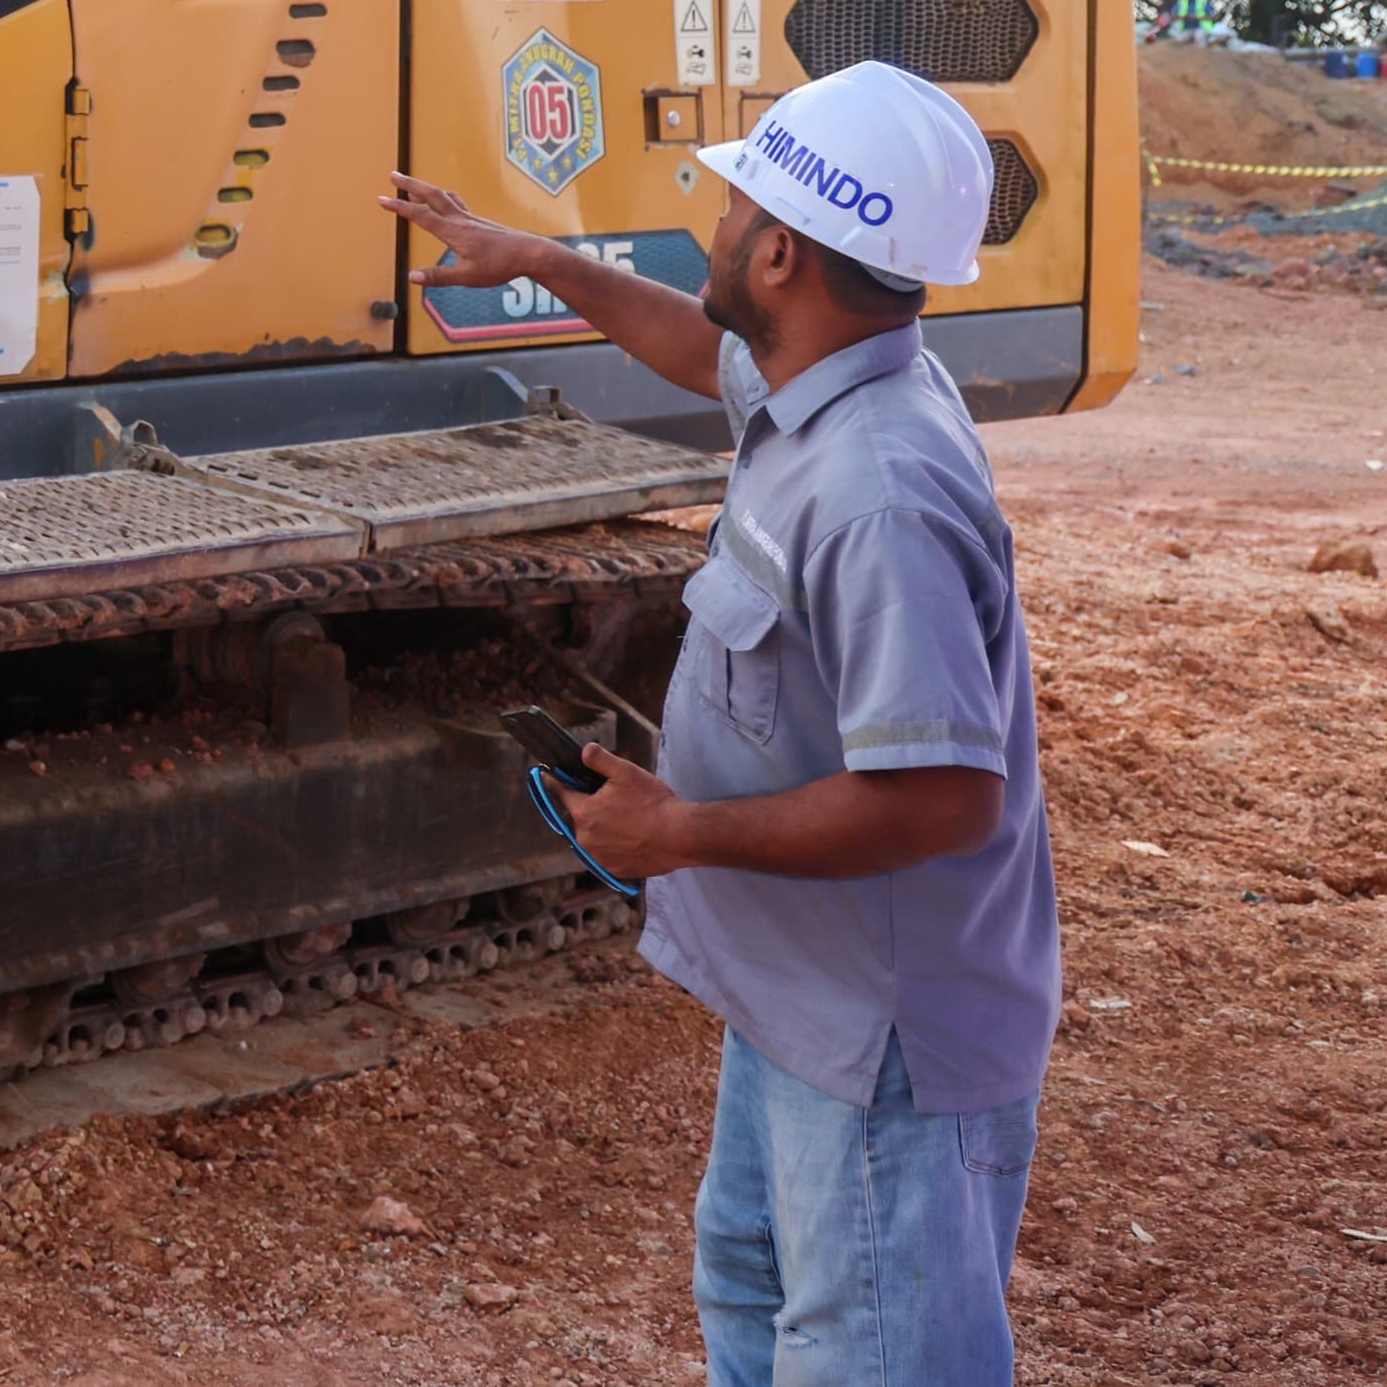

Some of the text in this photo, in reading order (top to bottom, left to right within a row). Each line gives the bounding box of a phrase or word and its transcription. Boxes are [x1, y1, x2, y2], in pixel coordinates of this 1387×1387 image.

[519, 43, 576, 75] ANUGRAH
[572, 72, 597, 160] PONDASI
[528, 83, 571, 141] 05
[755, 120, 894, 227] HIMINDO
